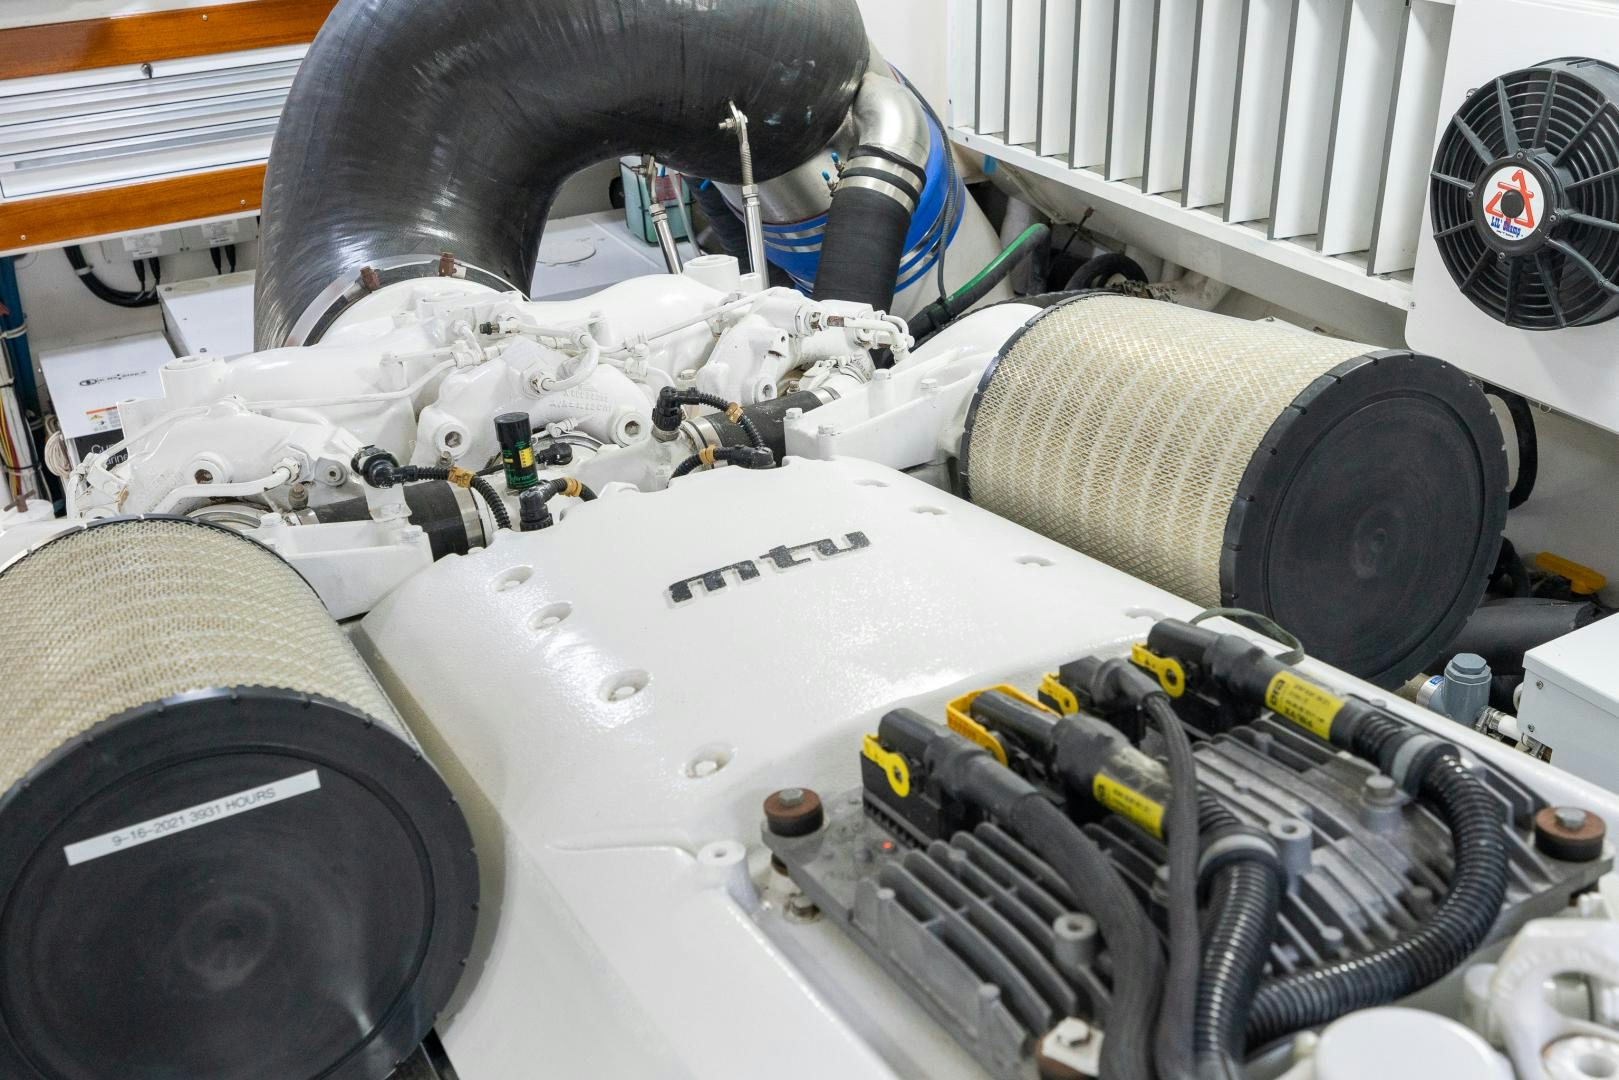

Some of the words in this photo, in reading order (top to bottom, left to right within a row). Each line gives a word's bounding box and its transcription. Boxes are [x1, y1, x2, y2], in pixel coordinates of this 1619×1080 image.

[666, 530, 872, 605] mtu
[111, 815, 187, 847] 9-16-2021
[225, 787, 277, 812] HOURS
